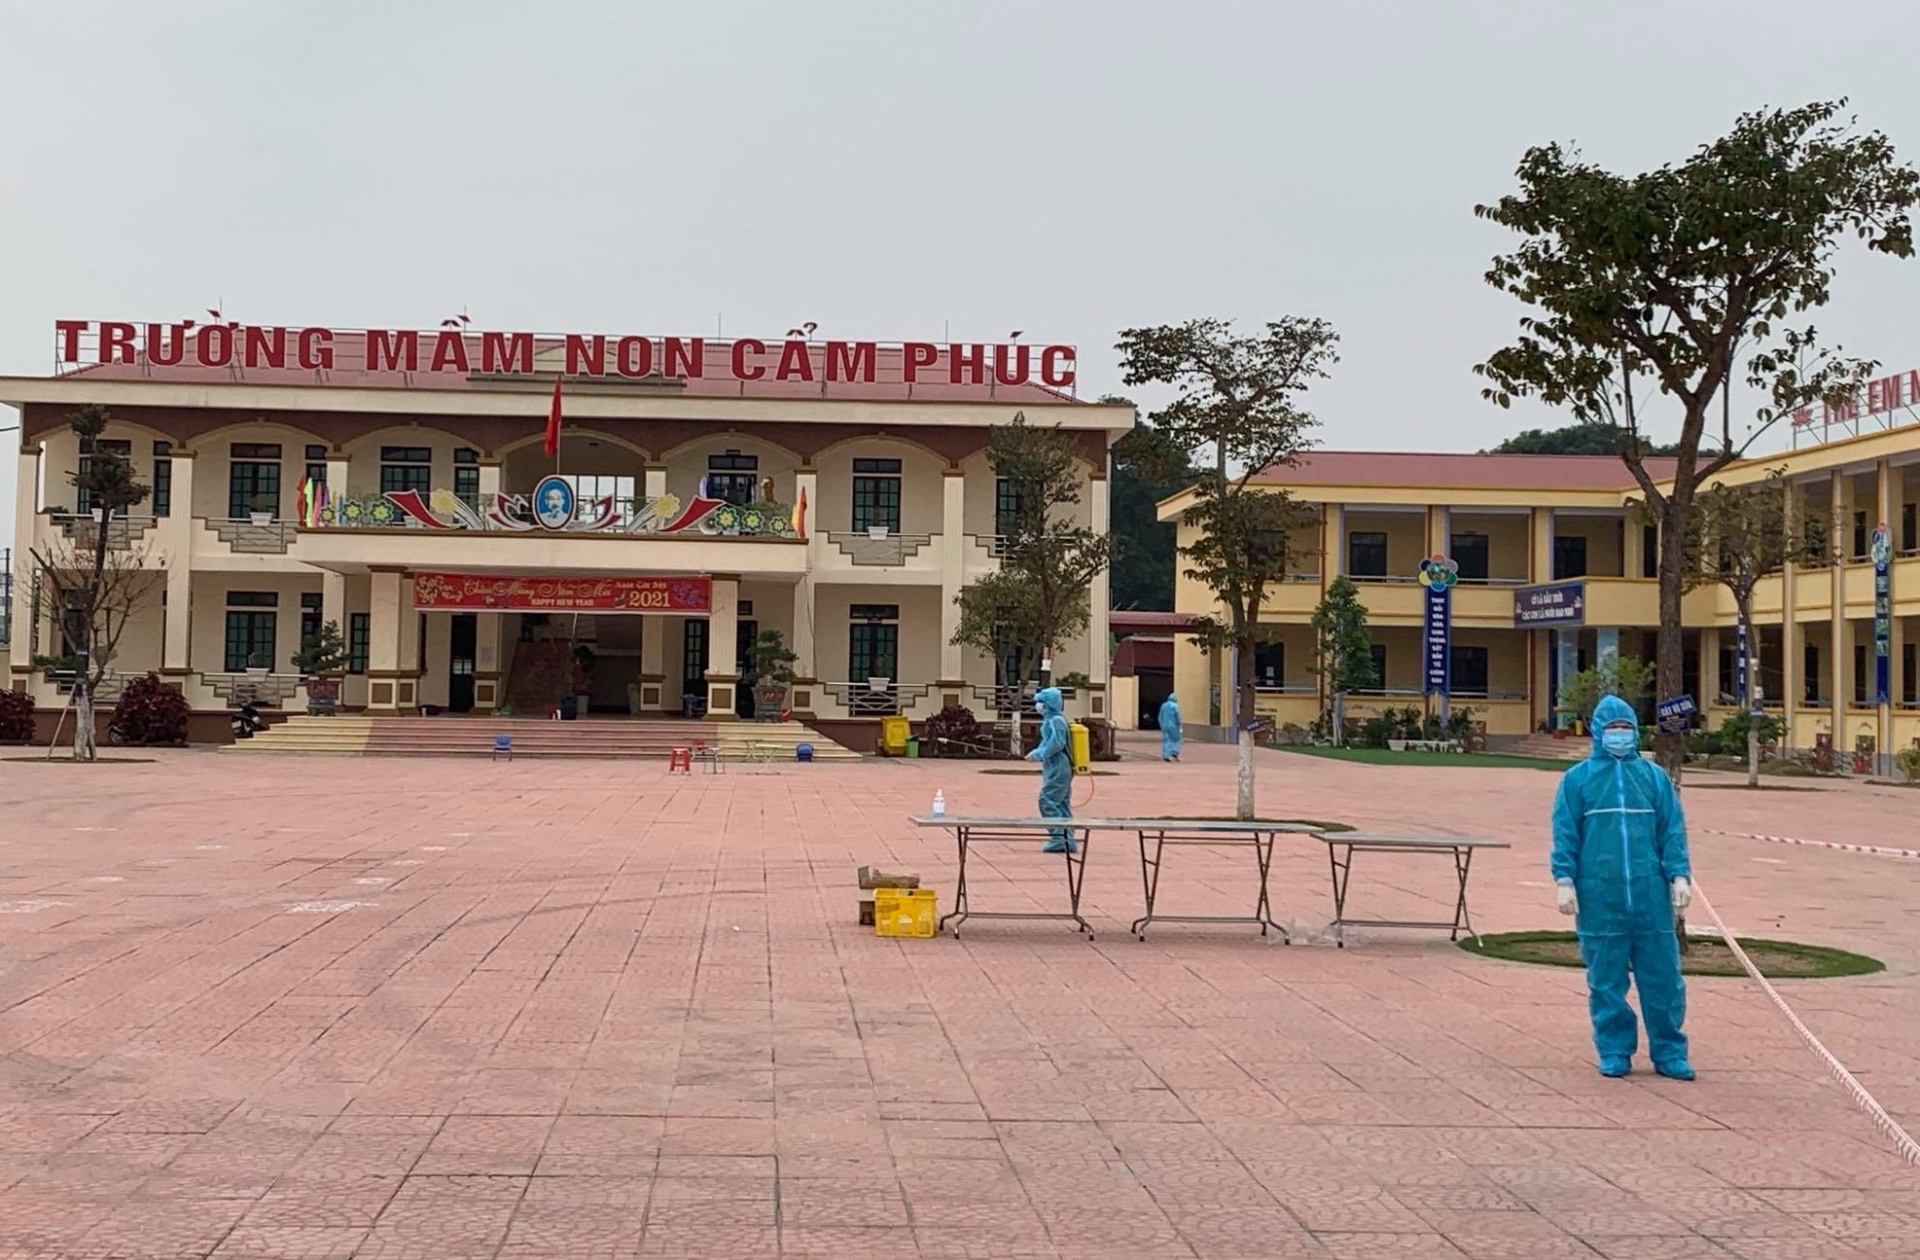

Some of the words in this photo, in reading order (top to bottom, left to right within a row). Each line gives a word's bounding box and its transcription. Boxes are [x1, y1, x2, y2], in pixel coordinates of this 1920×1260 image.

[55, 308, 334, 371] TRƯỜNG
[365, 315, 535, 375] MẦM
[564, 333, 704, 380] NON
[730, 321, 877, 383] CẨM
[903, 330, 1077, 387] PHÚC
[1868, 374, 1901, 414] EM
[531, 598, 555, 606] HAPPY
[575, 599, 594, 607] YEAR
[628, 590, 671, 608] 2021
